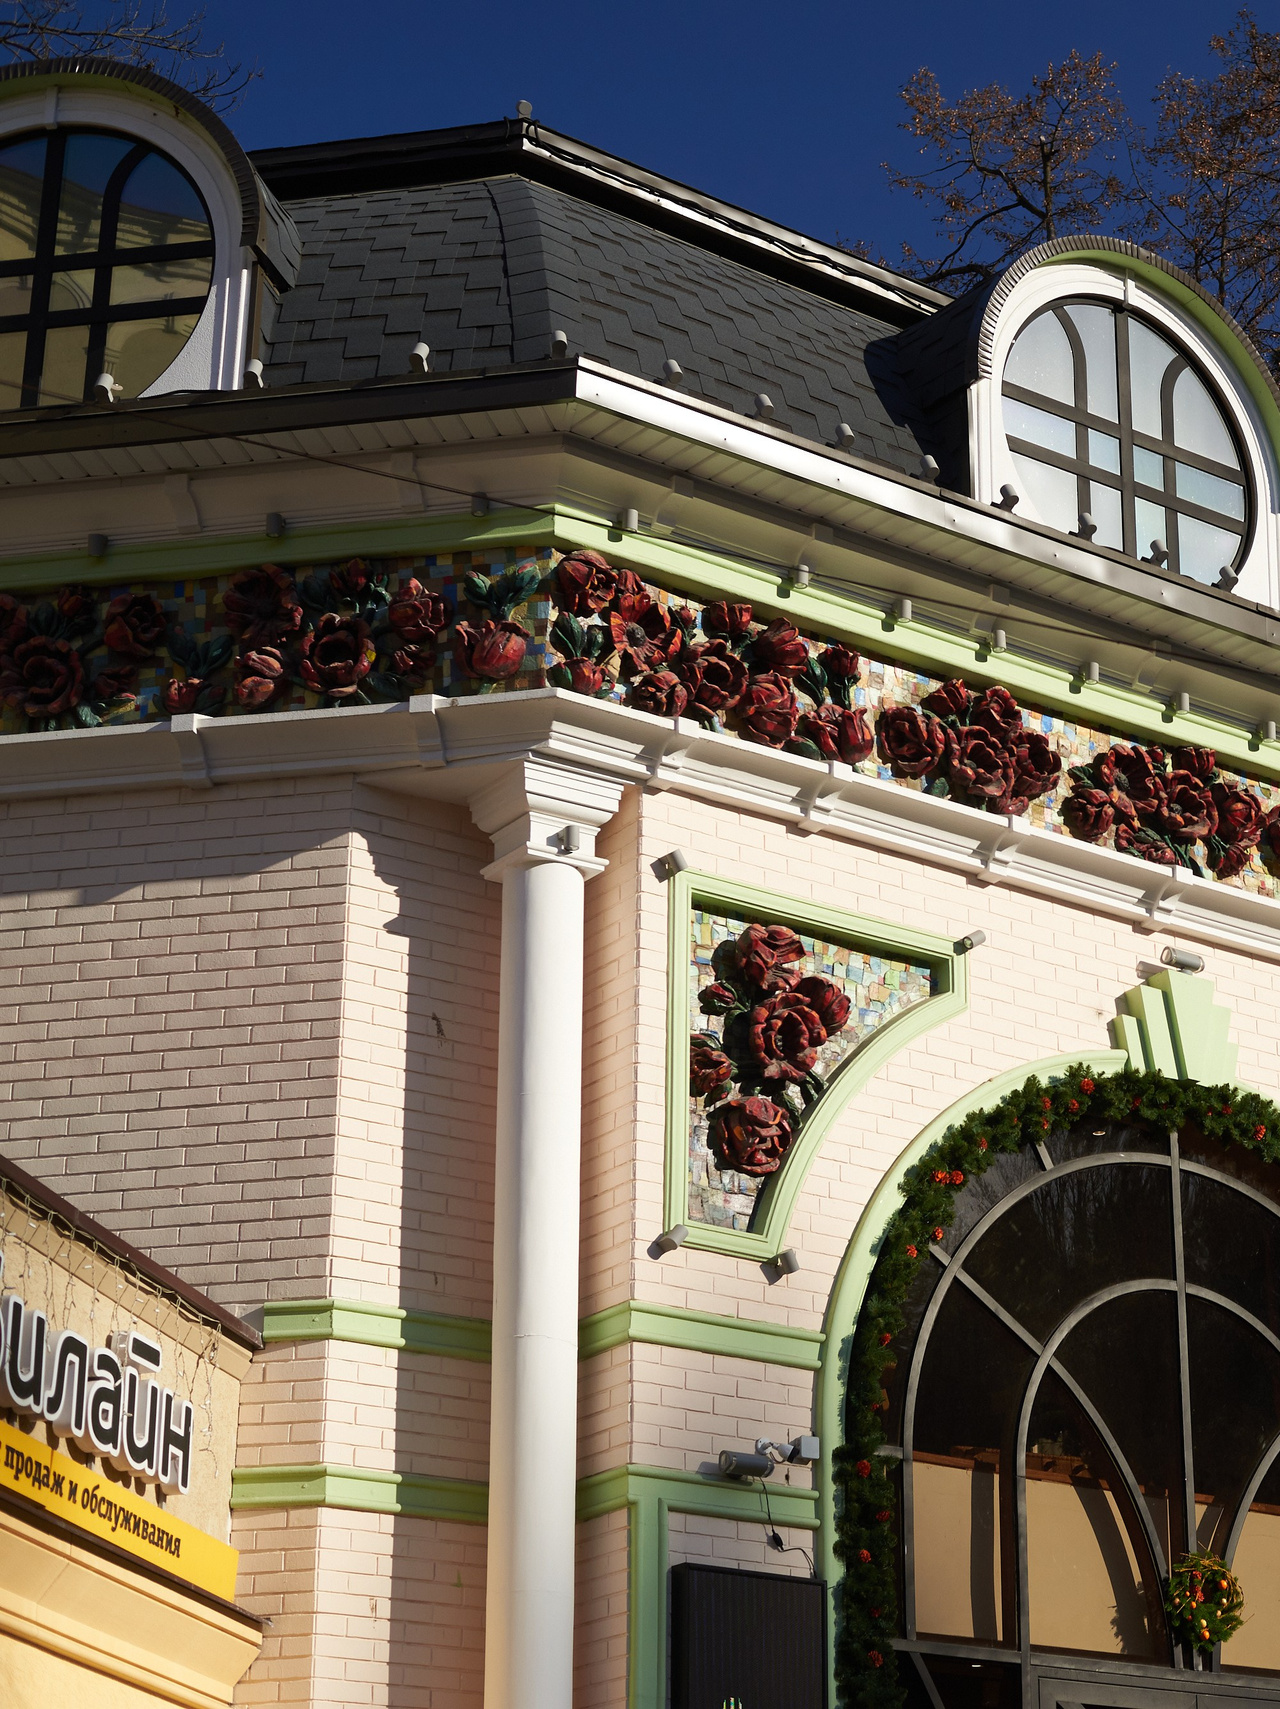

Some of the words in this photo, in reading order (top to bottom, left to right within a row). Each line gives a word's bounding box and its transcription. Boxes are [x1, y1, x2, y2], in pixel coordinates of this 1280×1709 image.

[0, 1254, 193, 1495] илайн
[4, 1445, 65, 1497] продаж
[68, 1480, 78, 1504] и
[81, 1484, 181, 1558] обслуживания
